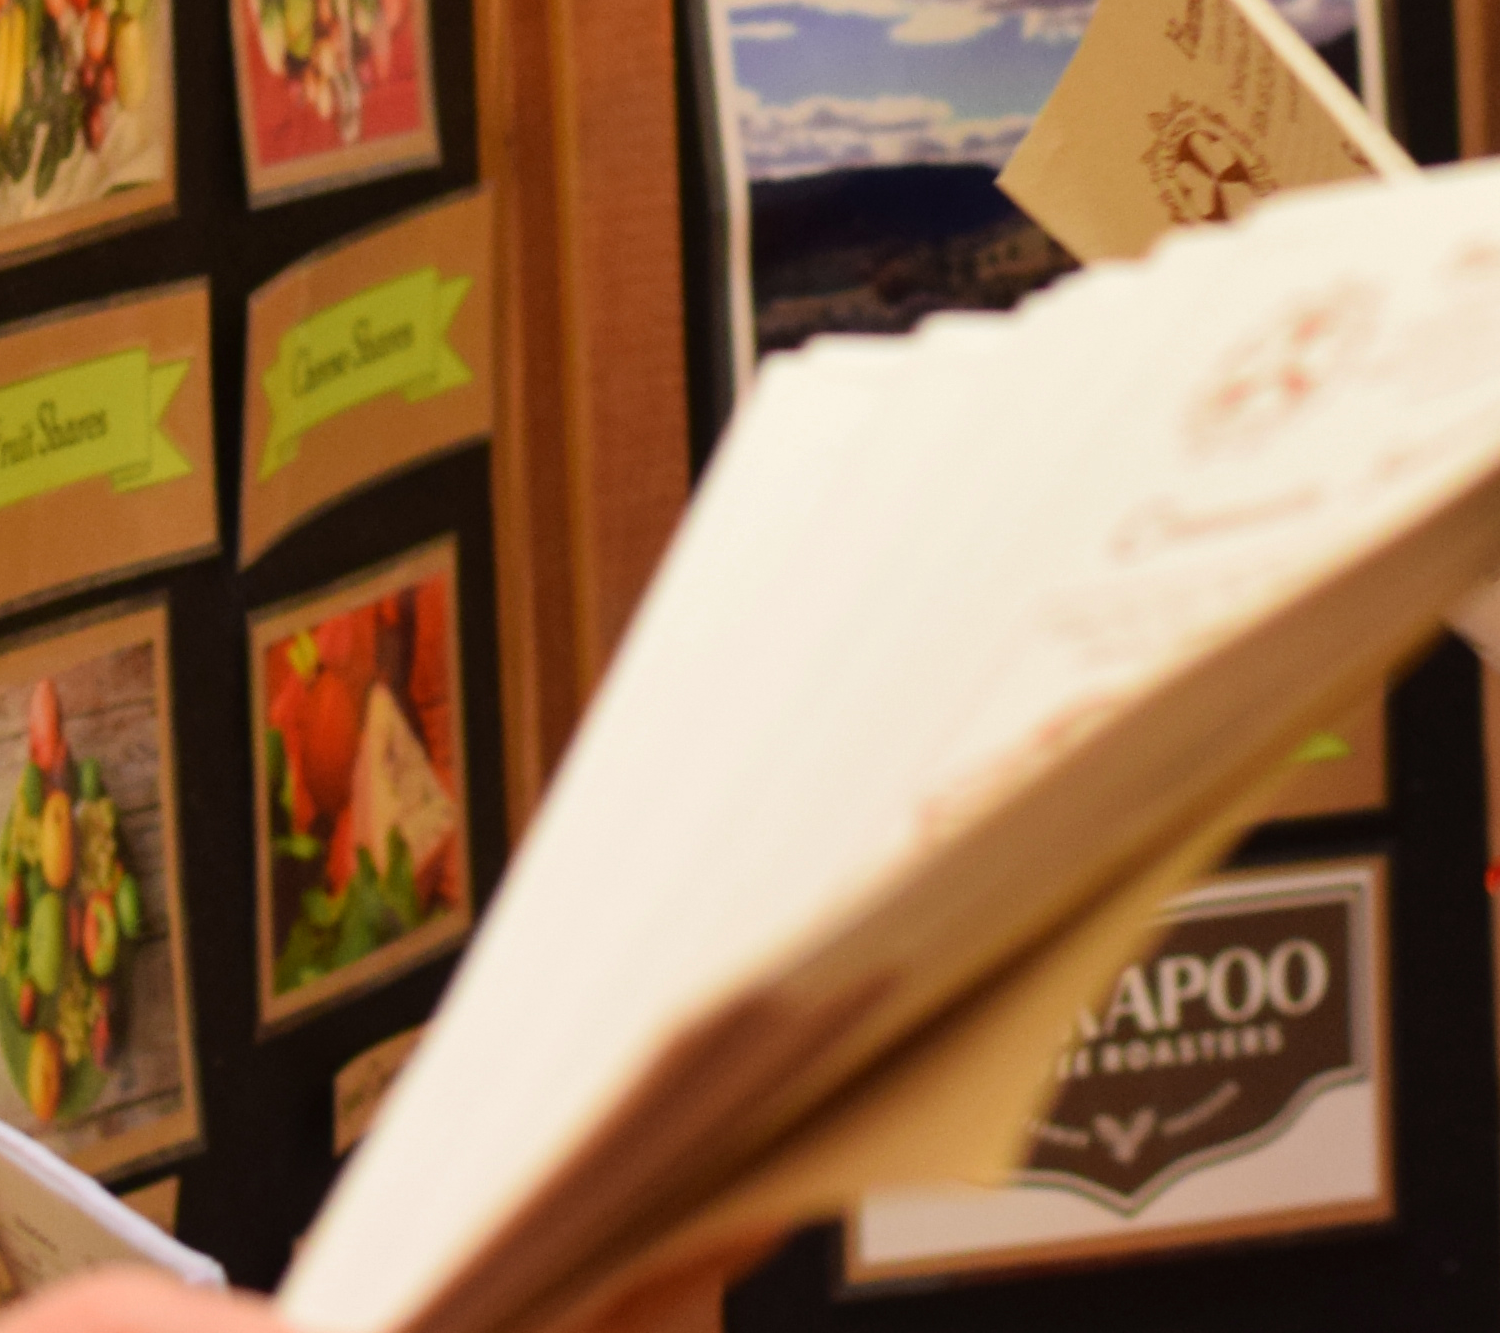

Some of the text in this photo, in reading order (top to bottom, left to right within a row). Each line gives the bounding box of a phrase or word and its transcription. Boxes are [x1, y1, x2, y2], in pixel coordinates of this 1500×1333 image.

[351, 316, 416, 370] Shares
[37, 398, 108, 457] Shares
[1100, 1021, 1285, 1075] ROASTERS
